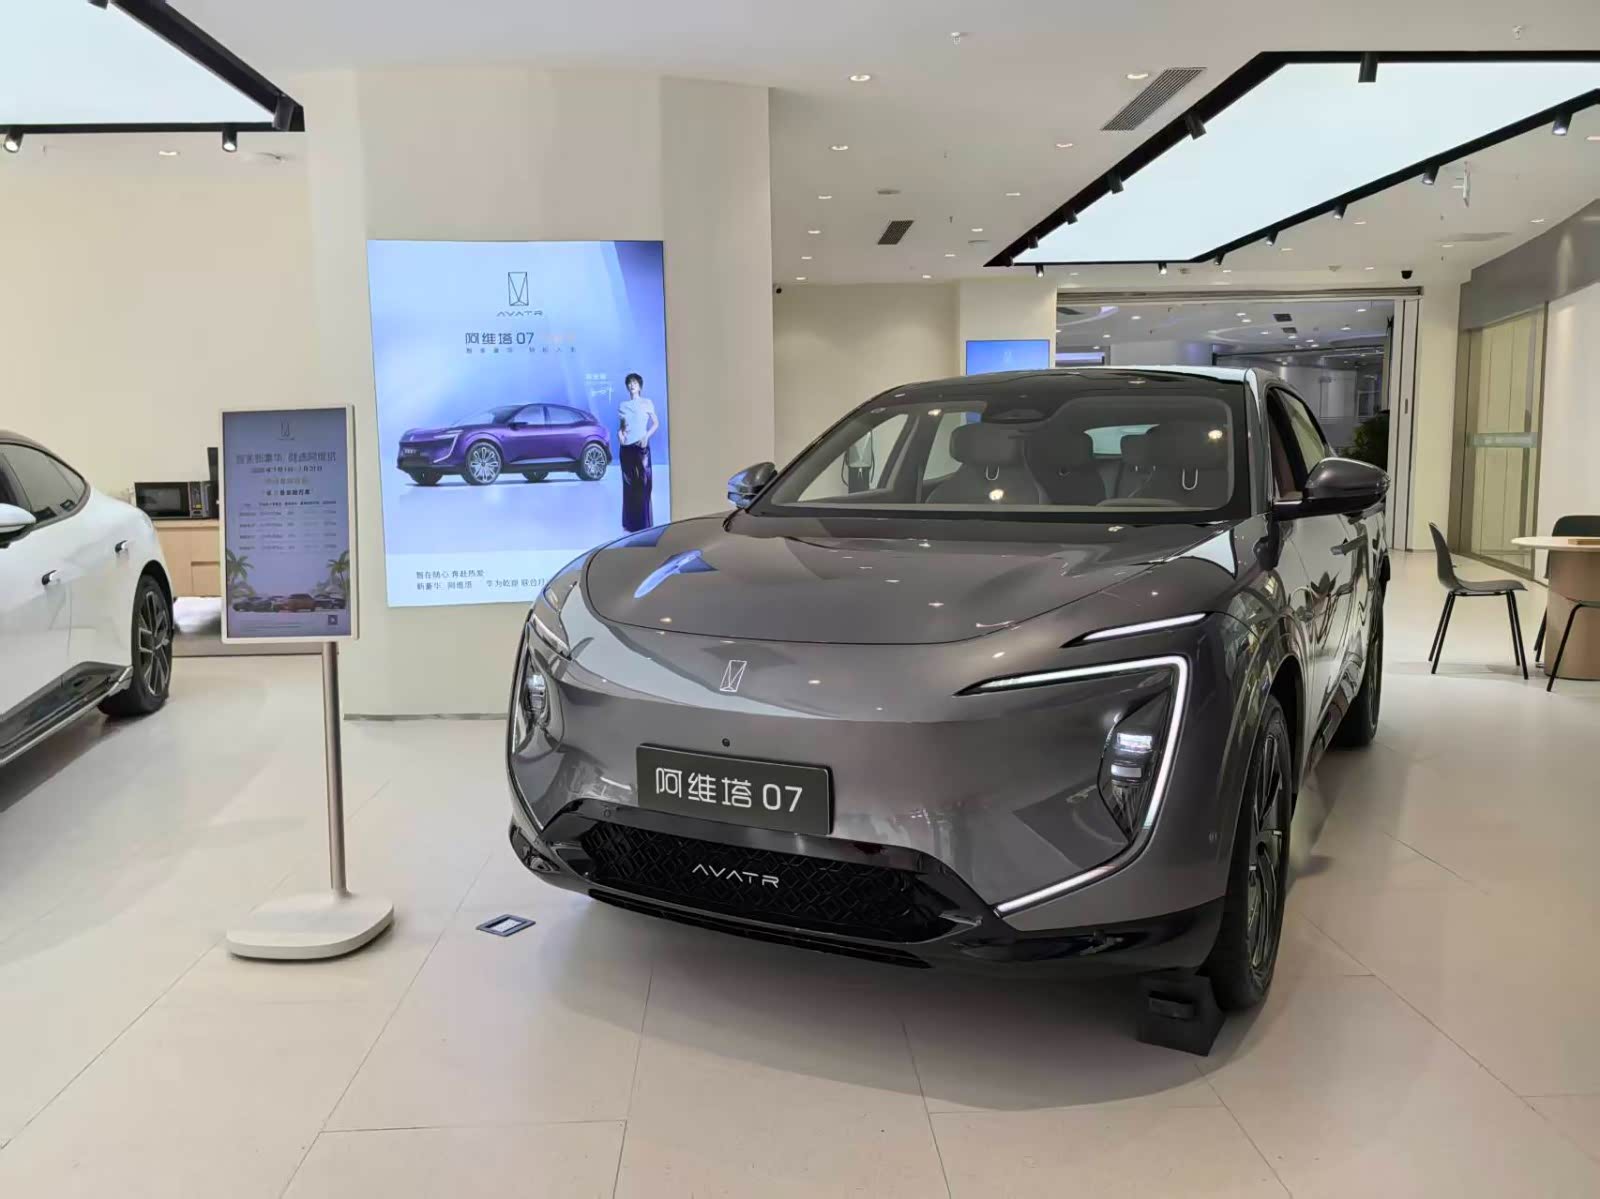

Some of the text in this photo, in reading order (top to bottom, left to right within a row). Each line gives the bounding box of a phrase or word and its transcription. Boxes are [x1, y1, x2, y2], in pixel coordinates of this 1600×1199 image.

[465, 332, 512, 345] 阿维塔
[516, 332, 534, 345] 07
[656, 767, 802, 812] 阿维塔 07
[692, 863, 779, 888] AVATR
